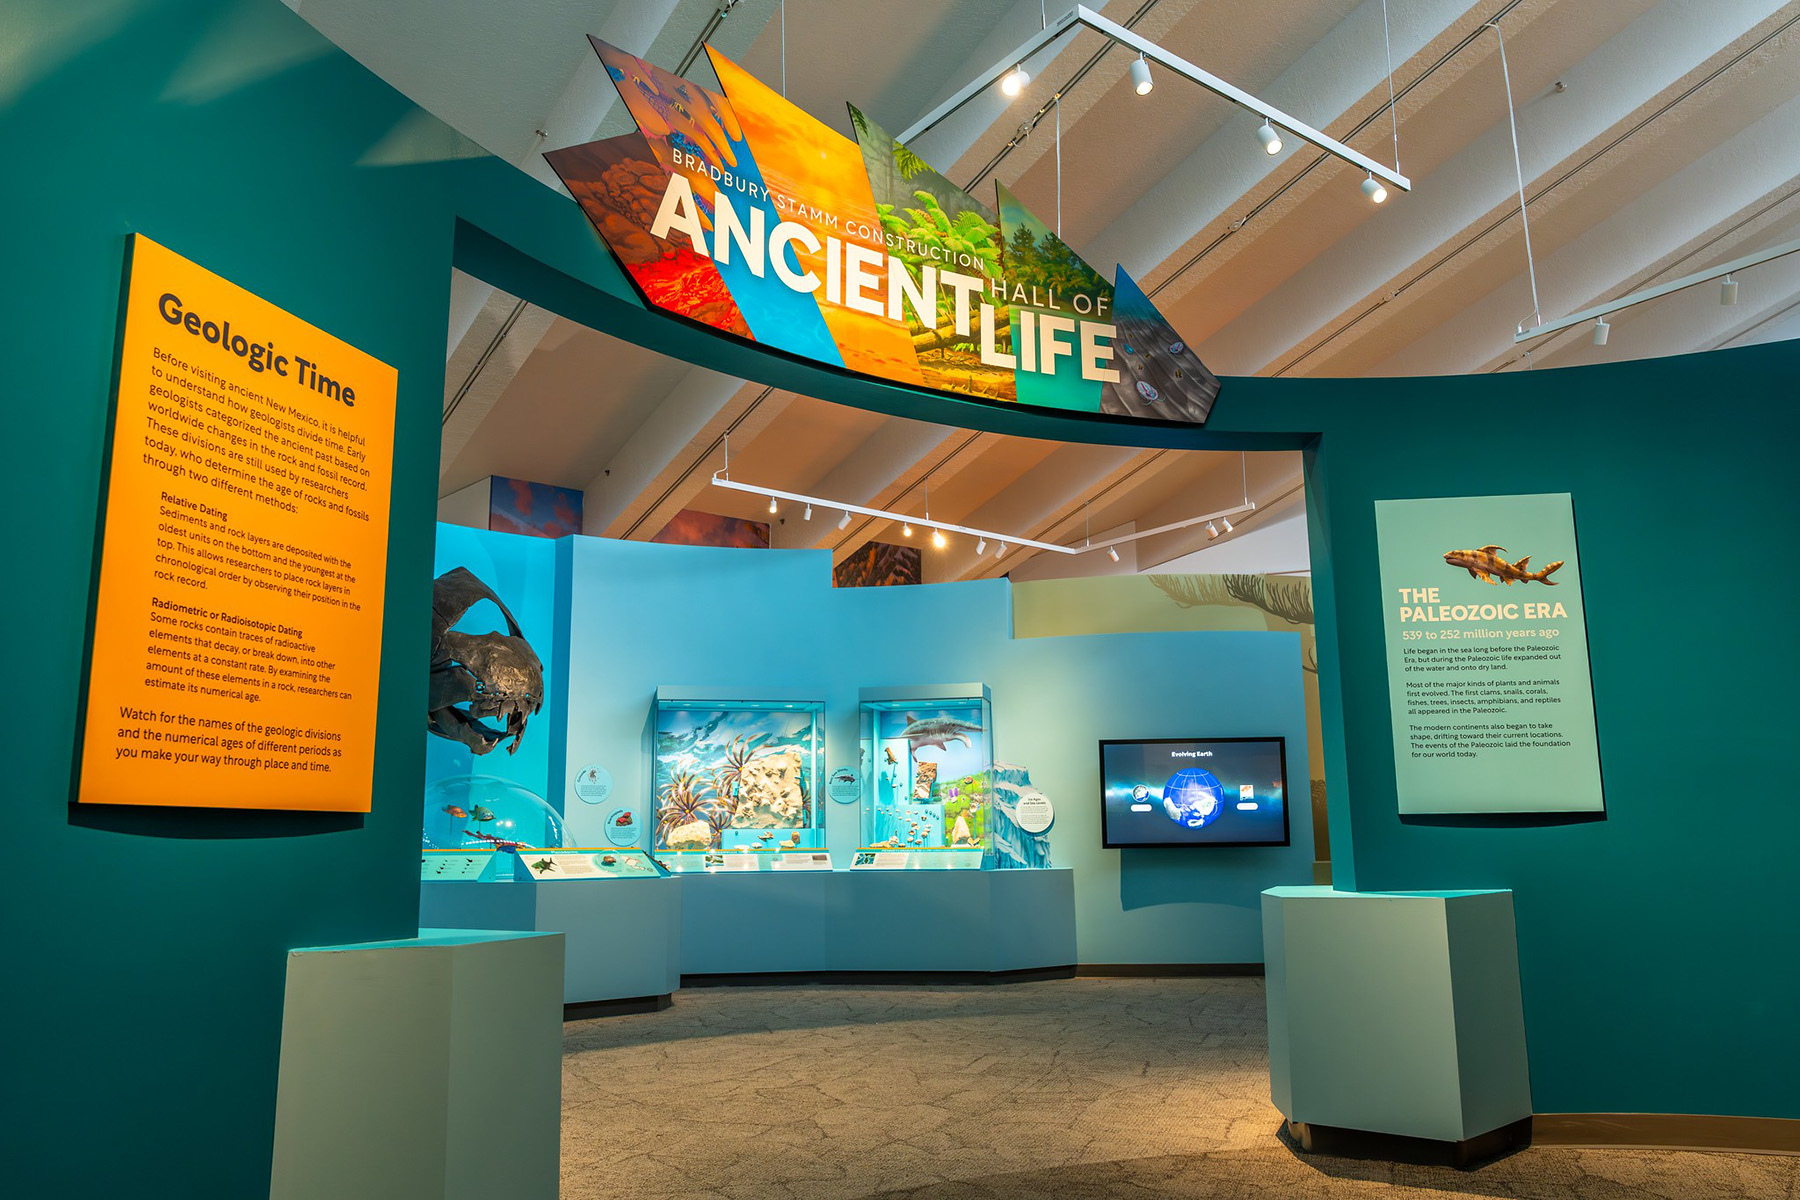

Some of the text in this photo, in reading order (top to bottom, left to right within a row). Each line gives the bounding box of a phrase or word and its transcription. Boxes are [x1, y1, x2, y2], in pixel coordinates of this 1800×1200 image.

[671, 147, 985, 272] BRADBURY STAMM CONSTRUCTION
[649, 171, 984, 337] ANCIENT
[990, 277, 1109, 318] HALL OF
[159, 293, 355, 407] Geologic Time
[980, 303, 1121, 384] LIFE
[149, 385, 370, 477] geologists categorized the ancient past based on
[152, 365, 366, 463] to understand how geologists divide time. Early
[154, 347, 365, 446] Before visiting ancient New Mexico, it is helpful
[143, 453, 298, 514] through two different methods:
[145, 436, 369, 522] today, who determine the age of rocks and fossils
[147, 417, 348, 500] These divisions are still used by researchers
[148, 402, 367, 491] worldwide changes in the rock and fossil record.
[161, 491, 228, 522] Relative Dating
[1399, 587, 1440, 604] THE
[1400, 602, 1568, 622] PALEOZOIC ERA
[1403, 629, 1559, 640] 539 to 252 million years ago
[116, 748, 331, 772] you make your way through place and time.
[118, 728, 140, 739] and
[144, 729, 162, 741] the
[165, 734, 218, 746] numerical
[221, 739, 243, 751] ages
[246, 740, 256, 750] of
[258, 741, 297, 753] different
[299, 745, 331, 756] periods
[120, 707, 341, 742] Watch for the names of the geologic divisions
